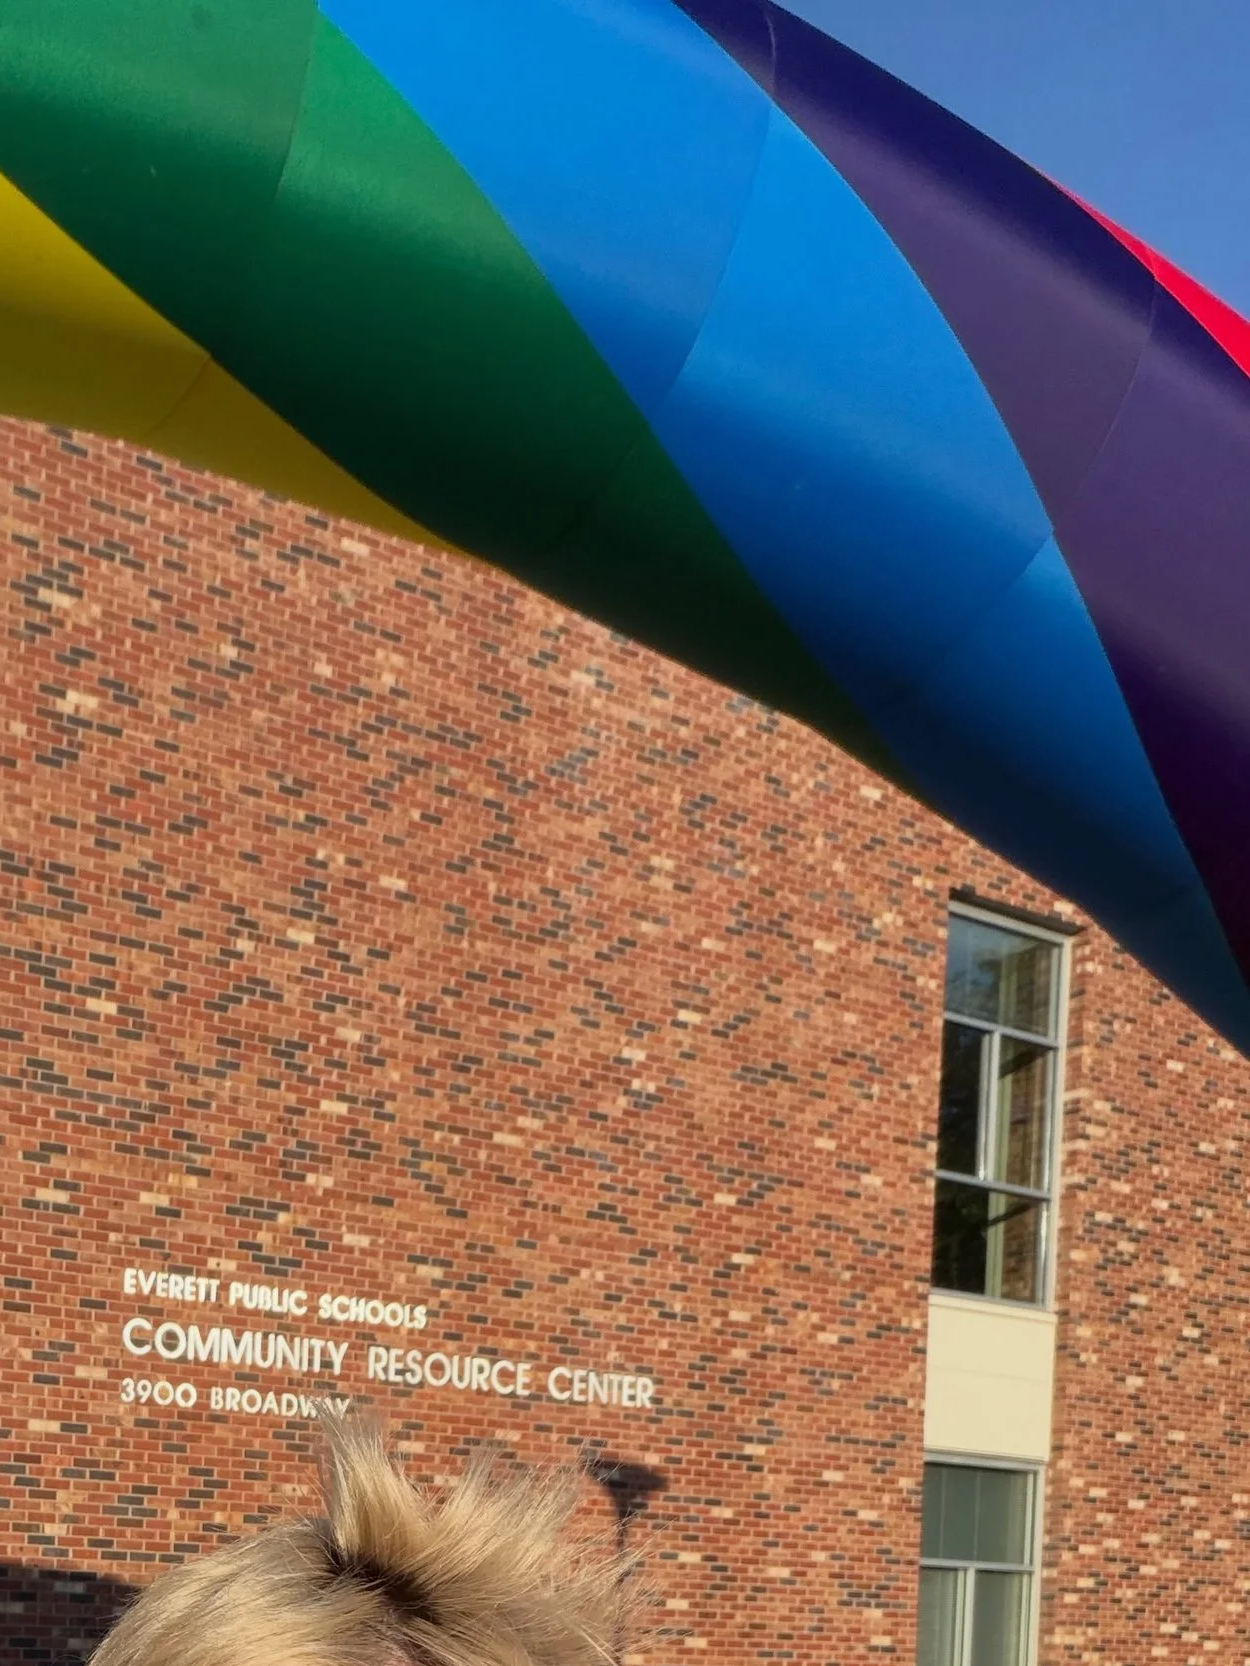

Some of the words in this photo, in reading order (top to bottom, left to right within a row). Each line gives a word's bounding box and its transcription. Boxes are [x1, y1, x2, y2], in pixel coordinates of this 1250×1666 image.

[123, 1268, 220, 1303] EVERETT
[229, 1281, 308, 1316] PUBLIC
[317, 1294, 427, 1330] SCHOOLS
[120, 1378, 198, 1409] 3900
[122, 1317, 349, 1376] COMMUNITY
[368, 1346, 532, 1398] RESOURCE
[547, 1366, 653, 1409] CENTER
